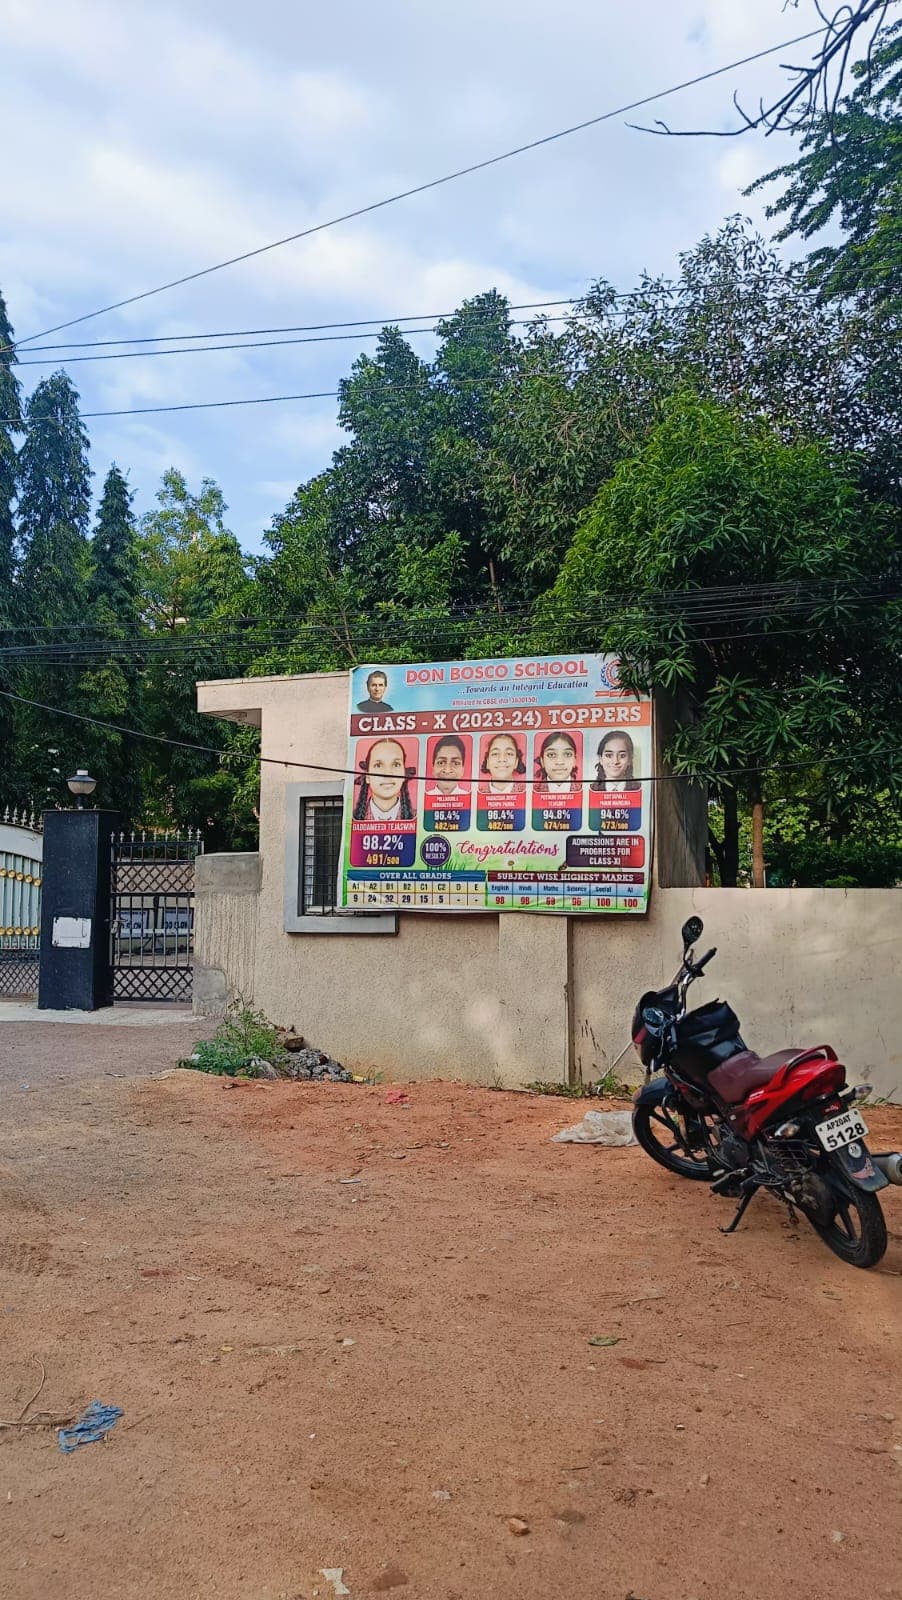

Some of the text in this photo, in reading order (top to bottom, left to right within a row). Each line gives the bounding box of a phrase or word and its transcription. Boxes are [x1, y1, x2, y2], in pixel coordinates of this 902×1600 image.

[406, 668, 444, 683] DON
[450, 665, 508, 681] BOSCO
[515, 660, 588, 677] SCHOOL
[512, 682, 545, 692] Integral
[547, 680, 588, 690] Education
[358, 715, 416, 731] CLASS
[433, 714, 447, 729] X
[452, 710, 542, 731] (2023-24)
[549, 706, 641, 725] TOPPERS
[434, 810, 460, 820] 96.4%
[487, 809, 514, 820] 96.4%
[543, 809, 571, 820] 94.8%
[600, 809, 629, 820] 94.6%
[362, 834, 404, 851] 98.2%
[571, 837, 639, 846] ADMISSIONS ARE IN
[425, 842, 447, 852] 100%
[456, 839, 560, 862] Congratulations
[580, 847, 631, 856] PROGRESS FOR
[366, 853, 400, 866] 491/500
[589, 857, 621, 865] CLASS-XI
[380, 872, 452, 880] OVER ALL GRADES
[497, 872, 634, 882] SUBJECT WISE HIGHEST MARKS
[352, 882, 360, 890] A1
[369, 882, 377, 890] A2
[420, 883, 428, 891] C1
[437, 883, 446, 891] C2
[456, 883, 462, 891] D
[367, 894, 377, 903] 24
[385, 894, 394, 903] 32
[420, 895, 429, 904] 15
[438, 895, 444, 904] 5
[597, 897, 611, 907] 100
[624, 898, 638, 908] 100
[826, 1115, 851, 1131] AP20AT
[826, 1122, 865, 1148] 5128
